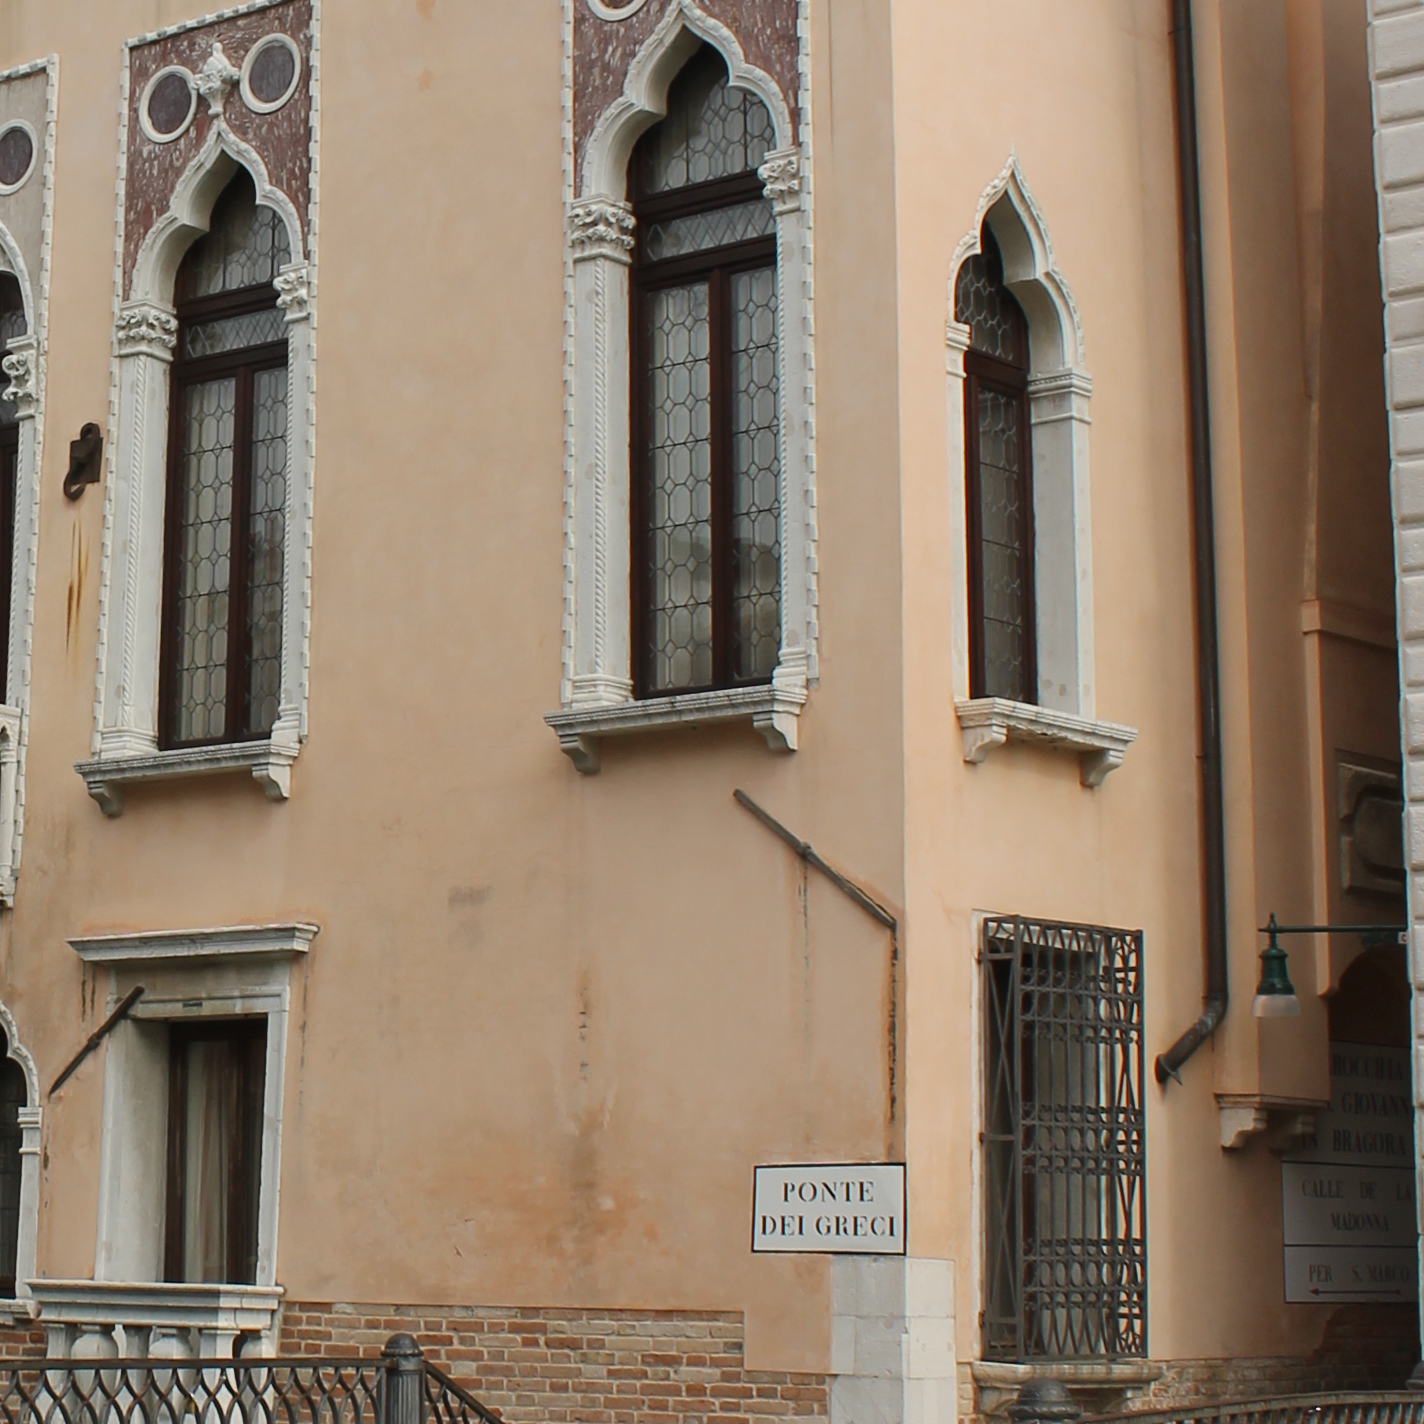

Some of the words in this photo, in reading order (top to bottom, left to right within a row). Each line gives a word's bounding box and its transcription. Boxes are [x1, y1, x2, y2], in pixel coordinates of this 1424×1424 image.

[1331, 1054, 1404, 1080] ROCCHIA
[1341, 1092, 1412, 1116] GIOVANN
[1333, 1129, 1406, 1156] BRAGORA
[783, 1181, 874, 1203] PONTE
[1302, 1179, 1343, 1198] CALLE
[761, 1215, 804, 1236] DEI
[815, 1215, 895, 1237] GRECI
[1331, 1213, 1390, 1231] MADONNA
[1309, 1264, 1332, 1283] PER
[1367, 1265, 1410, 1283] MARCO
